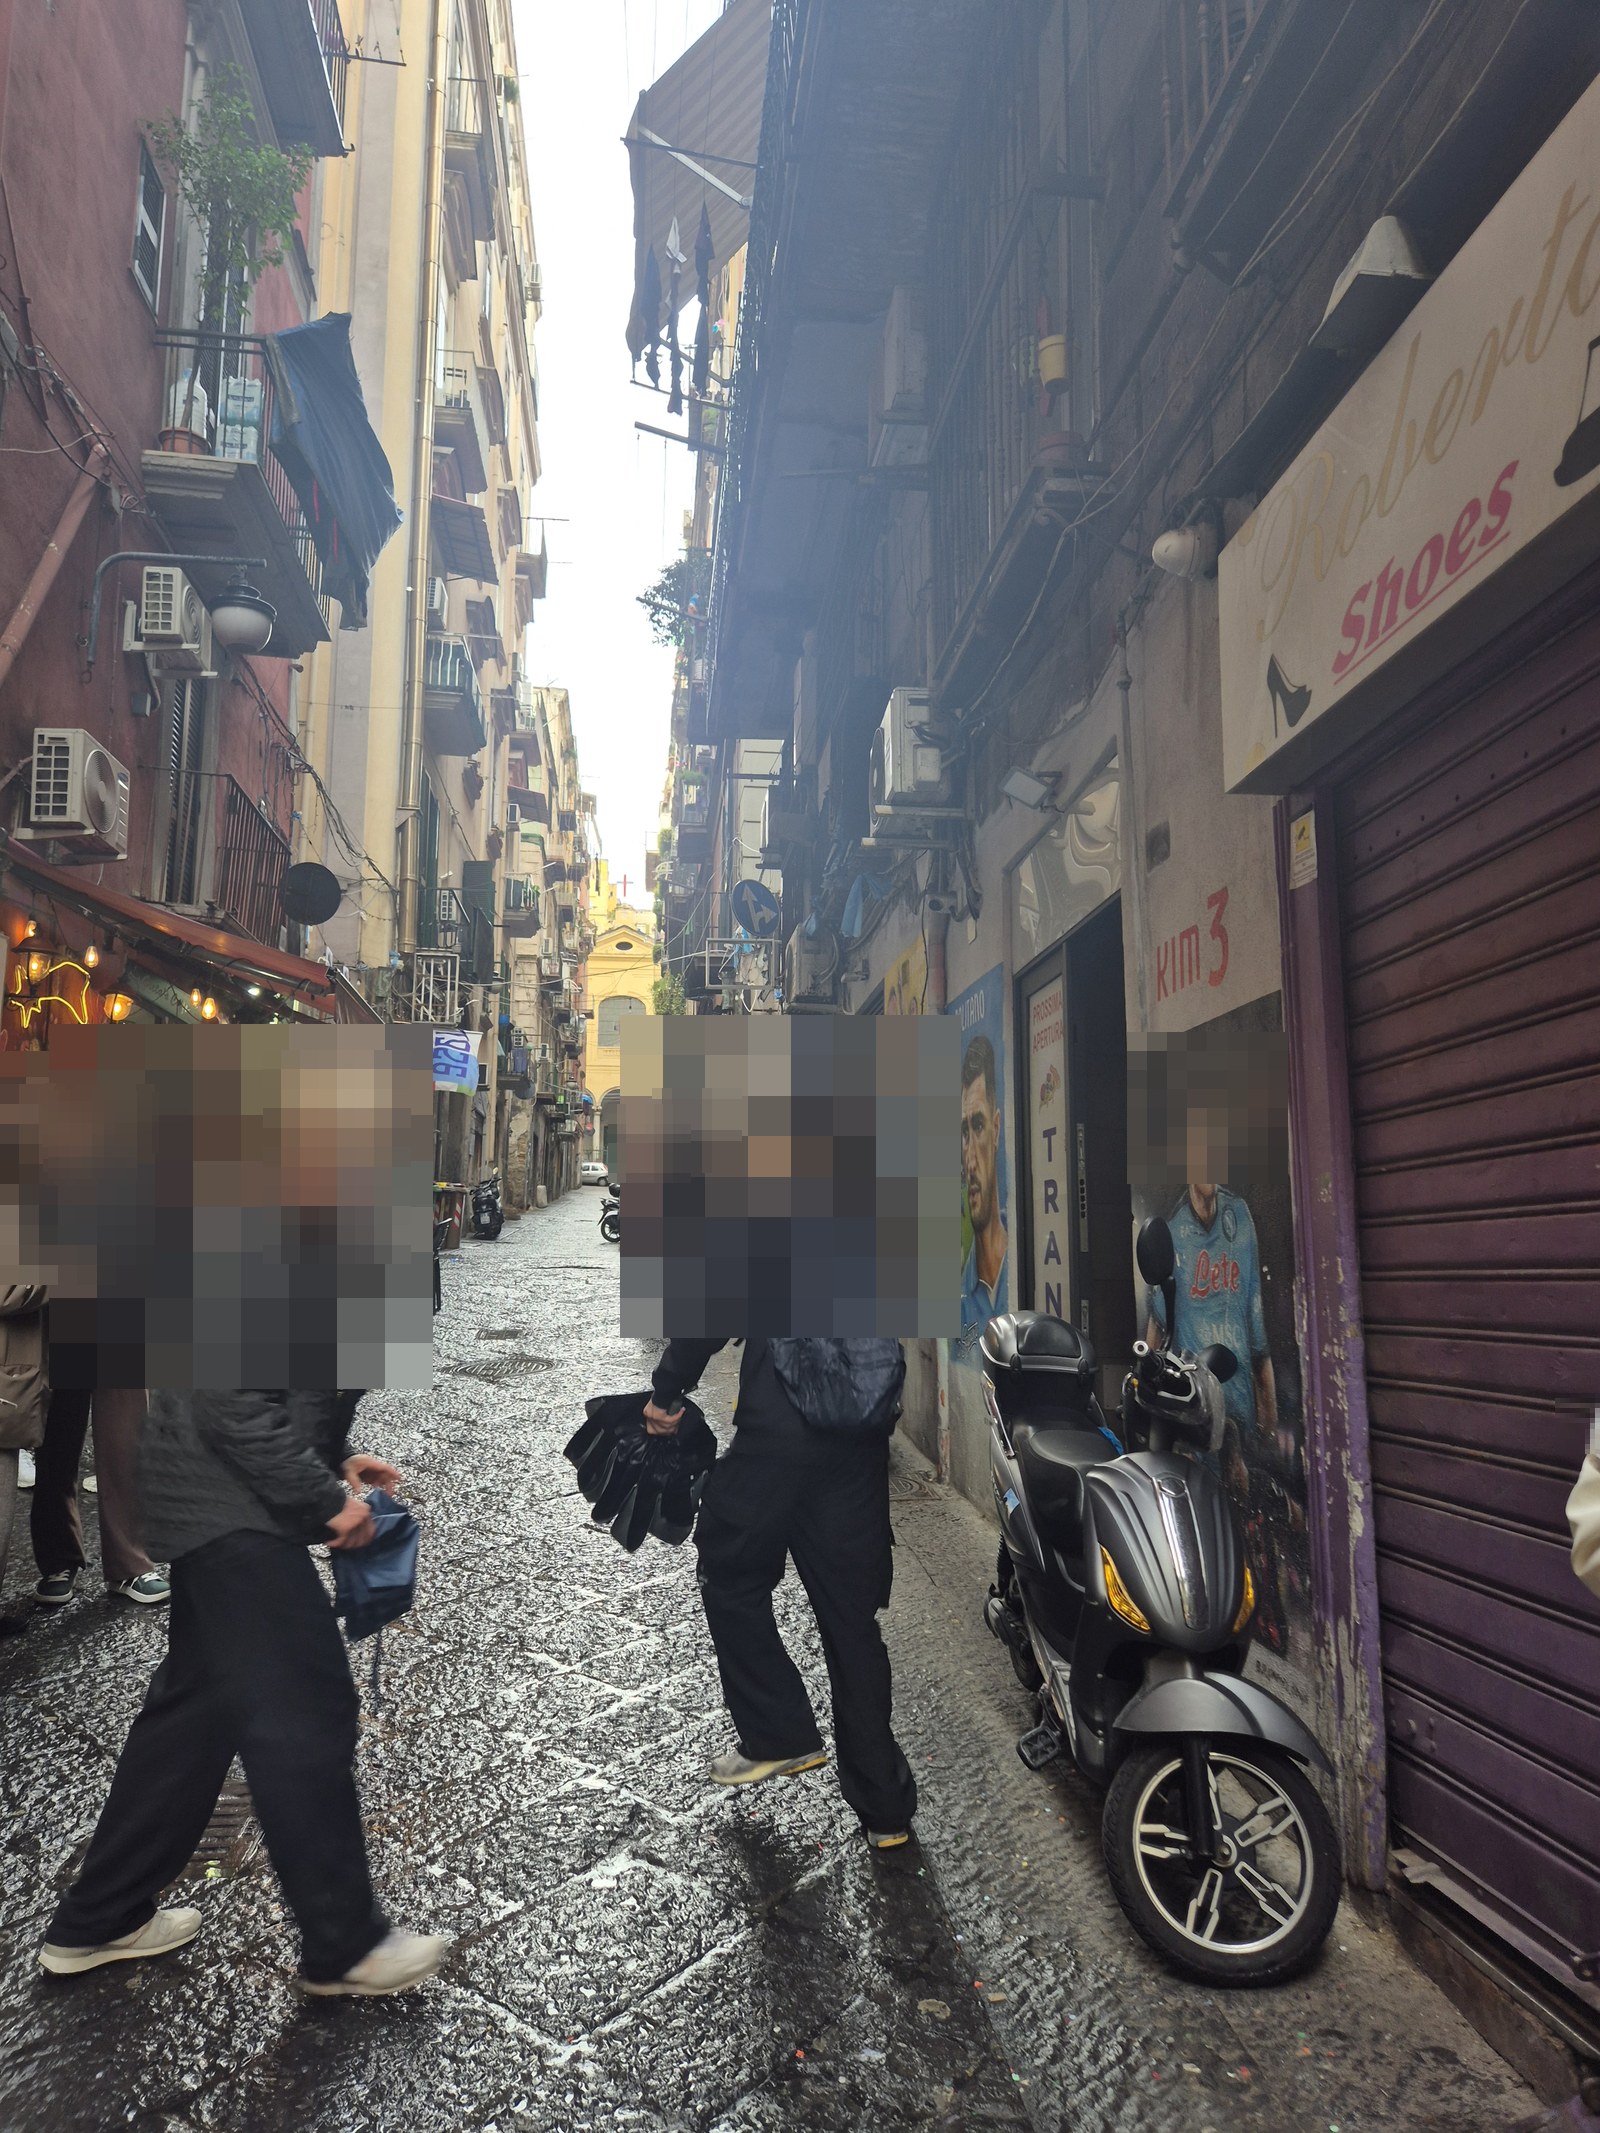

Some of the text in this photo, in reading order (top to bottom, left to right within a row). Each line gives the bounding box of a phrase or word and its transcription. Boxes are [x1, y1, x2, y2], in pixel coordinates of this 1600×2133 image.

[1157, 886, 1229, 1002] KIM 3
[1033, 990, 1063, 1026] PROSSIMA
[1033, 1019, 1064, 1055] APERTURA
[1190, 1249, 1240, 1298] Lete
